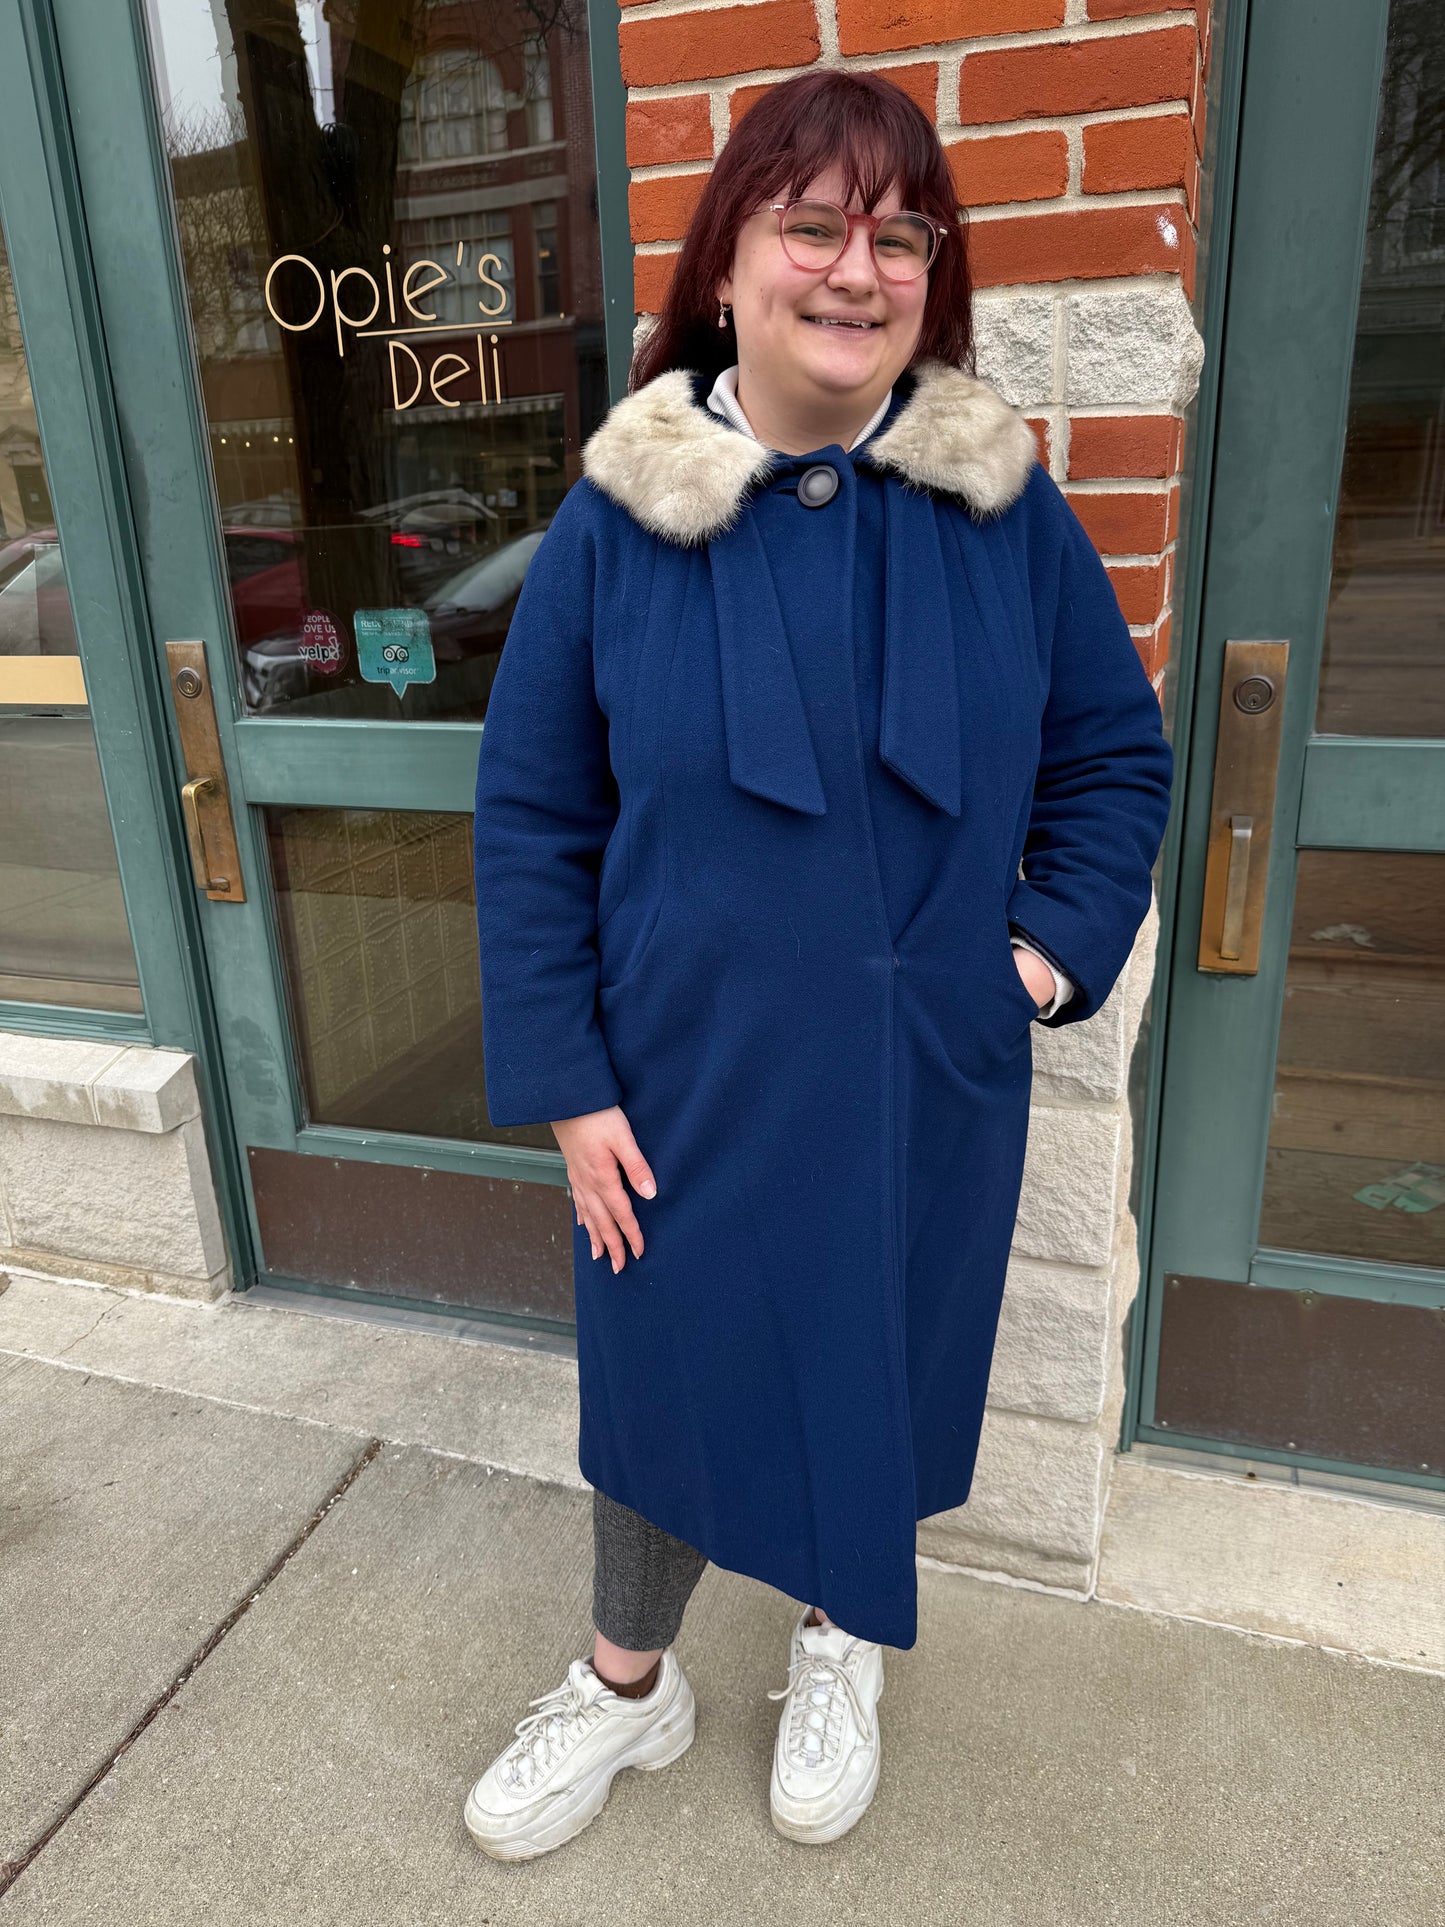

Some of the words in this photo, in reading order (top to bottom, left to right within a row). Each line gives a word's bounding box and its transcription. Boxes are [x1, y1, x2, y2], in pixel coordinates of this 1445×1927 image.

[265, 241, 506, 357] Opie's
[389, 334, 501, 411] Deli
[301, 624, 322, 633] OVE
[303, 615, 330, 623] EOPLE
[299, 643, 330, 664] yelp
